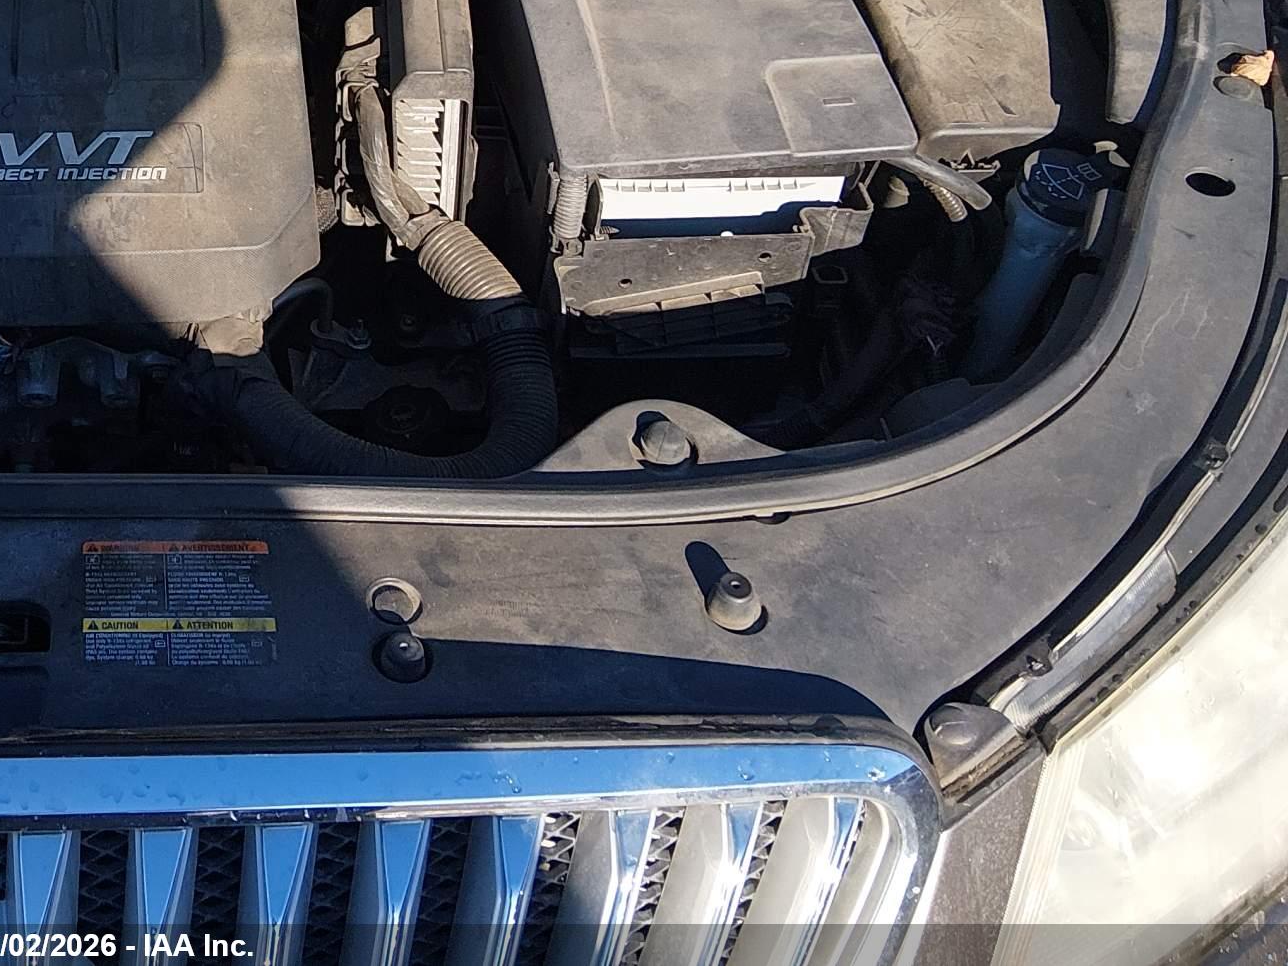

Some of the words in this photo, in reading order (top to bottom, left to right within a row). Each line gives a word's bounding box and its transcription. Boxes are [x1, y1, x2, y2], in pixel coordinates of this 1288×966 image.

[57, 165, 167, 181] INJECTION
[101, 621, 139, 630] CAUTION
[186, 621, 234, 630] ATTENTION
